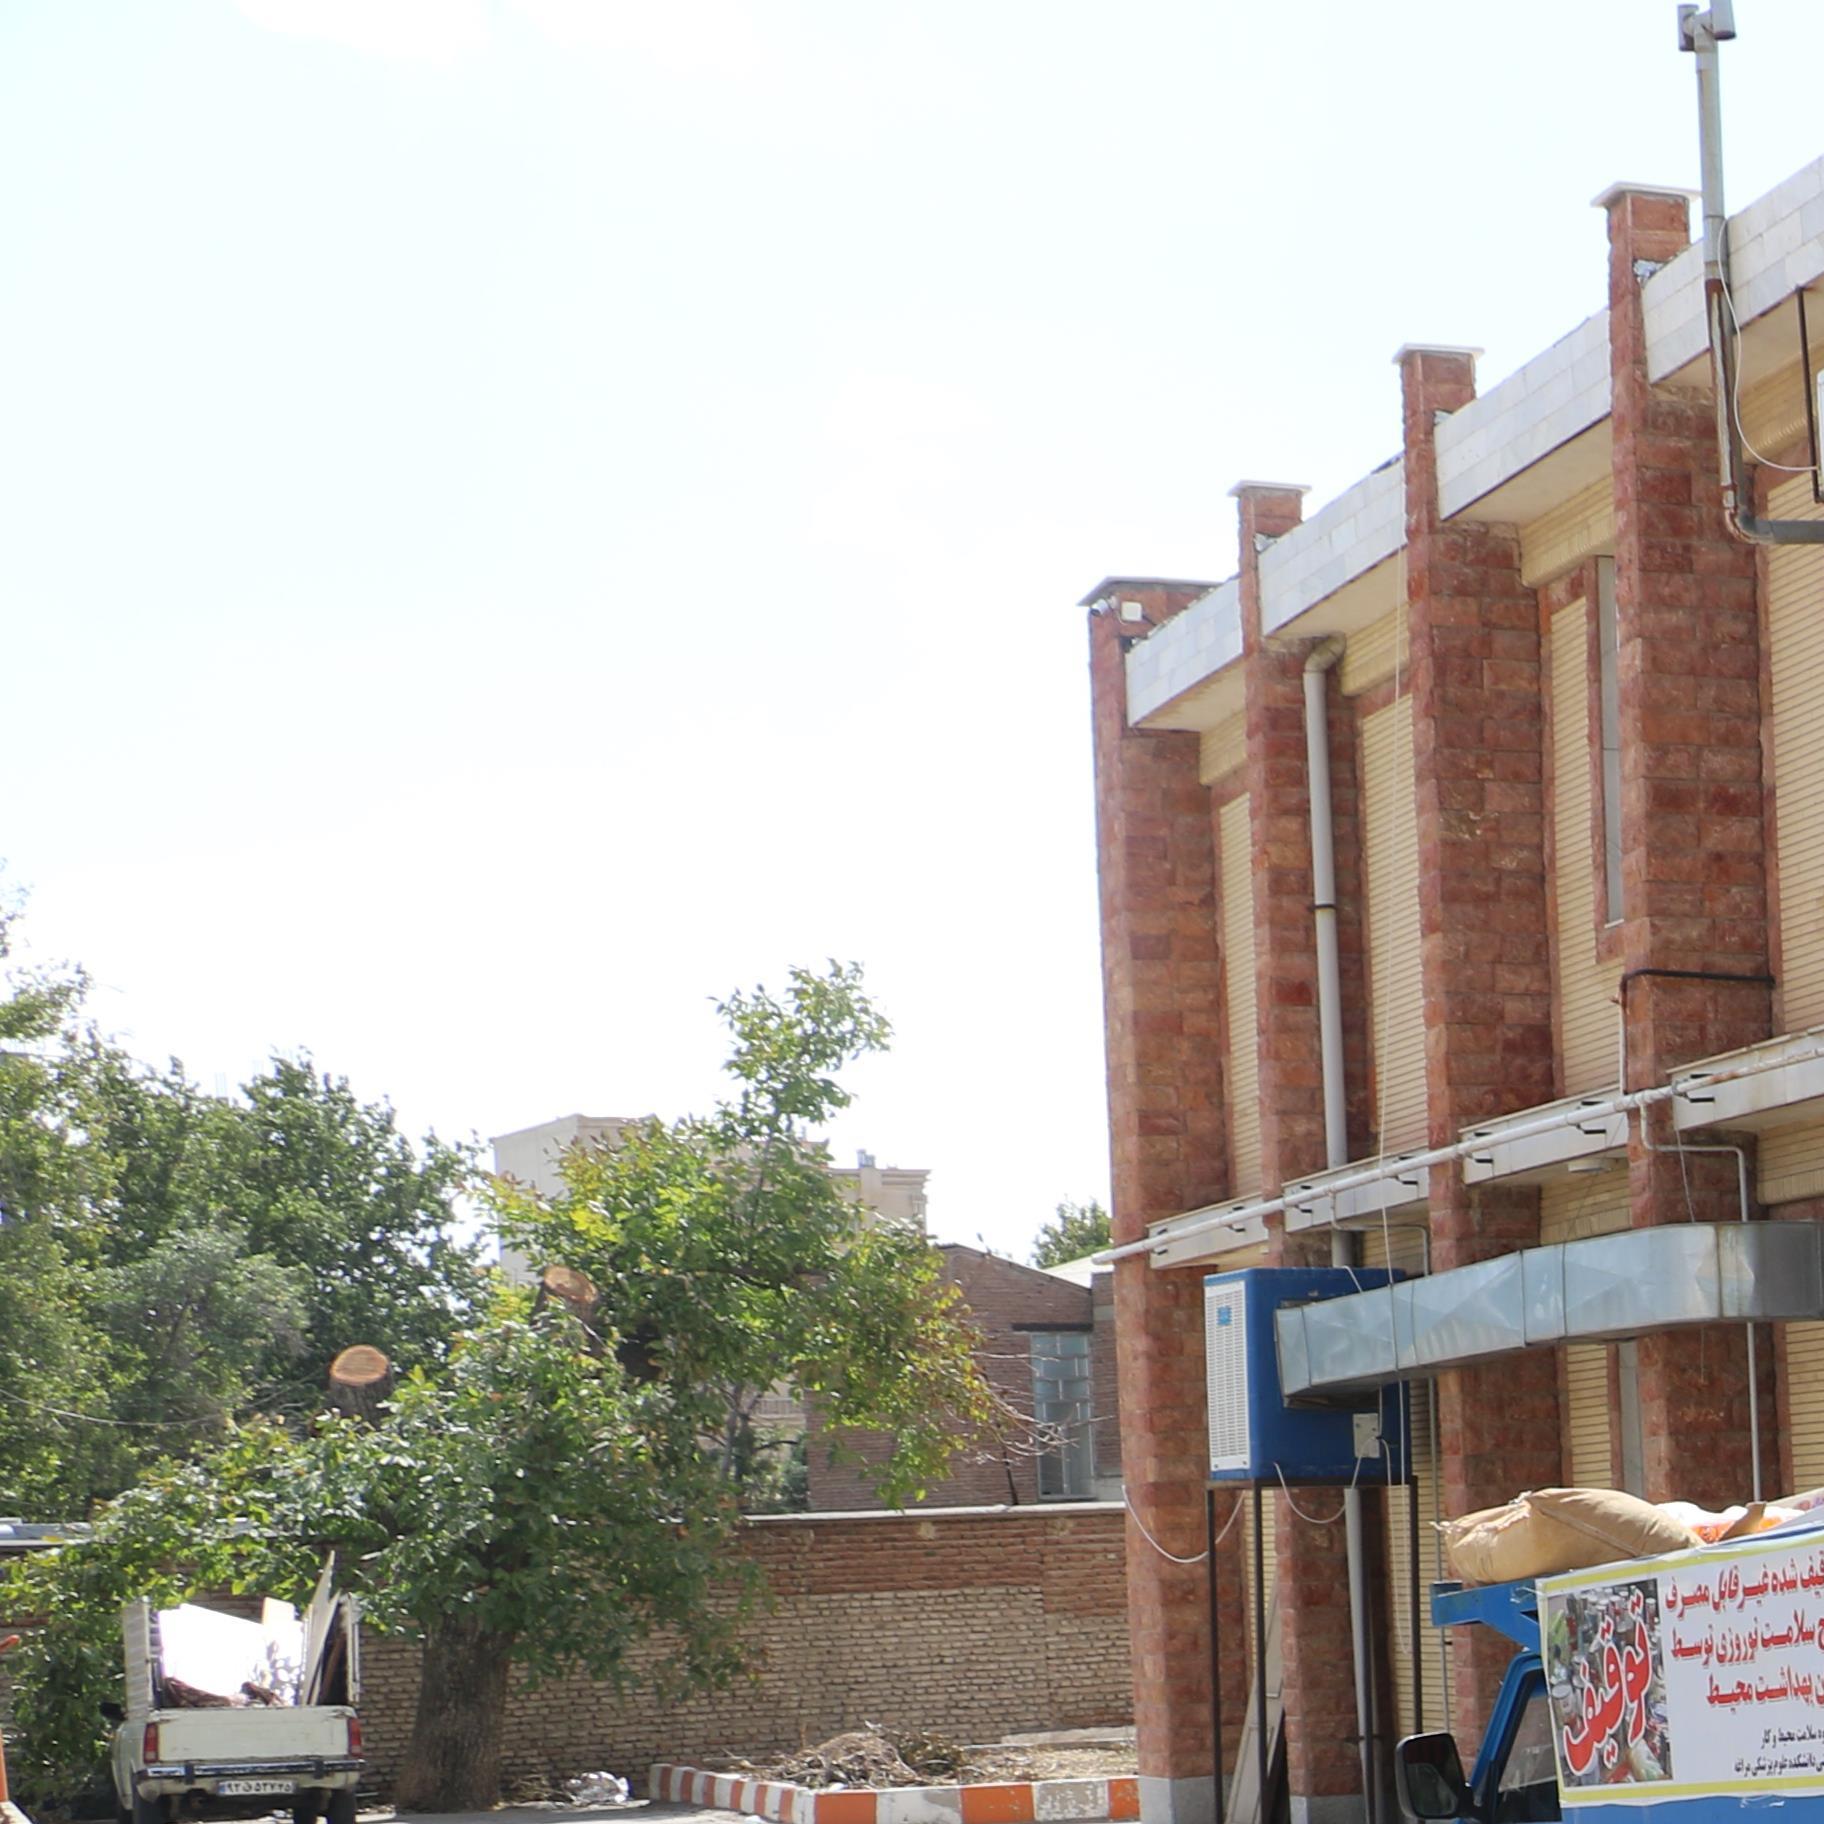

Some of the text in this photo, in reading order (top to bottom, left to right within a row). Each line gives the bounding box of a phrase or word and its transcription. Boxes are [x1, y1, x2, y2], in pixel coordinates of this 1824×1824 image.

[1712, 1564, 1739, 1611] قابل
[1738, 1562, 1769, 1609] غیر
[1771, 1557, 1797, 1593] شده
[1666, 1576, 1709, 1618] مصرف
[1671, 1624, 1713, 1666] توسط
[1716, 1616, 1757, 1663] نوروزی
[1761, 1608, 1814, 1648] سلامت
[1563, 1585, 1651, 1775] توقیف
[1707, 1673, 1752, 1712] محیط
[1755, 1664, 1812, 1705] بهداشت
